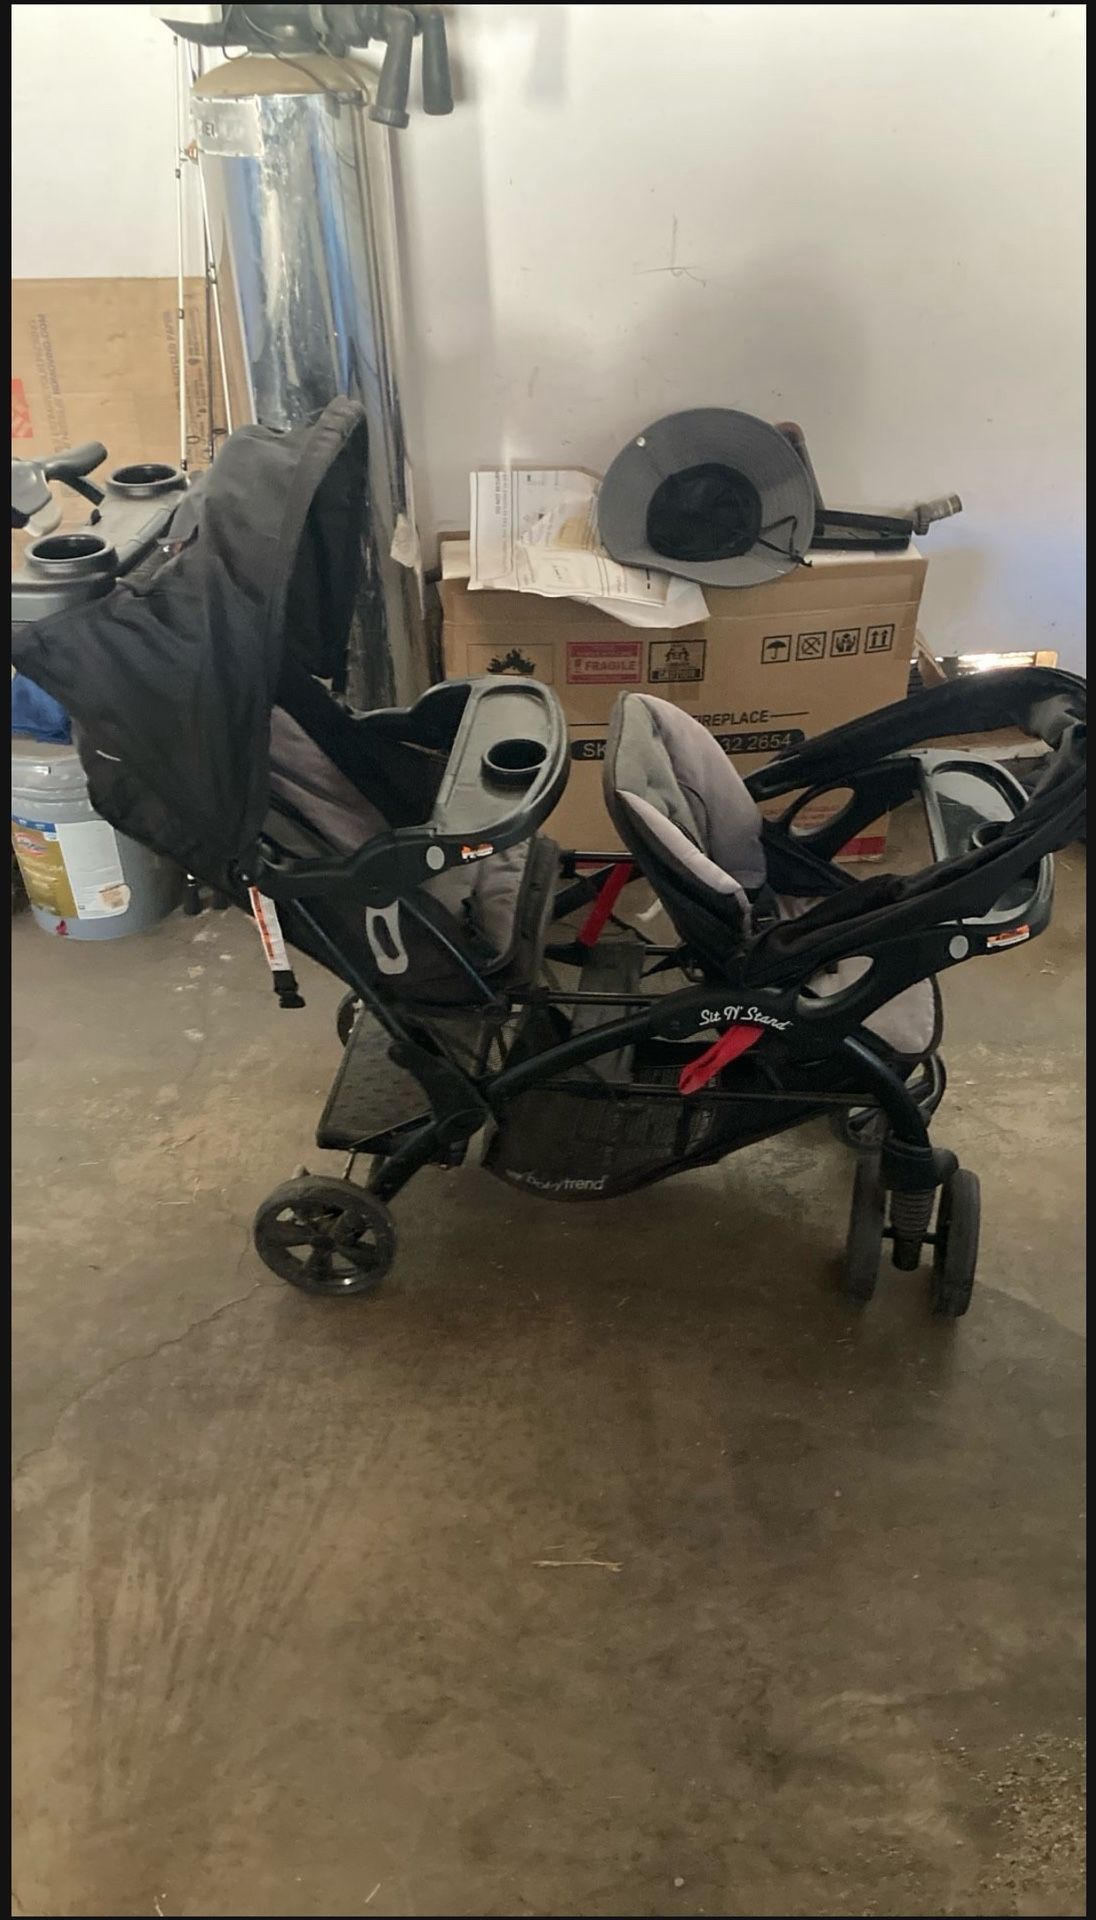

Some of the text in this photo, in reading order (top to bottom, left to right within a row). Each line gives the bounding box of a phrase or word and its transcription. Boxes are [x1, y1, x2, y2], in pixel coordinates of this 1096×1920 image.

[584, 660, 637, 672] FRAGILE
[747, 733, 792, 751] 2654
[698, 1009, 722, 1026] Sit
[740, 1006, 789, 1031] Stand
